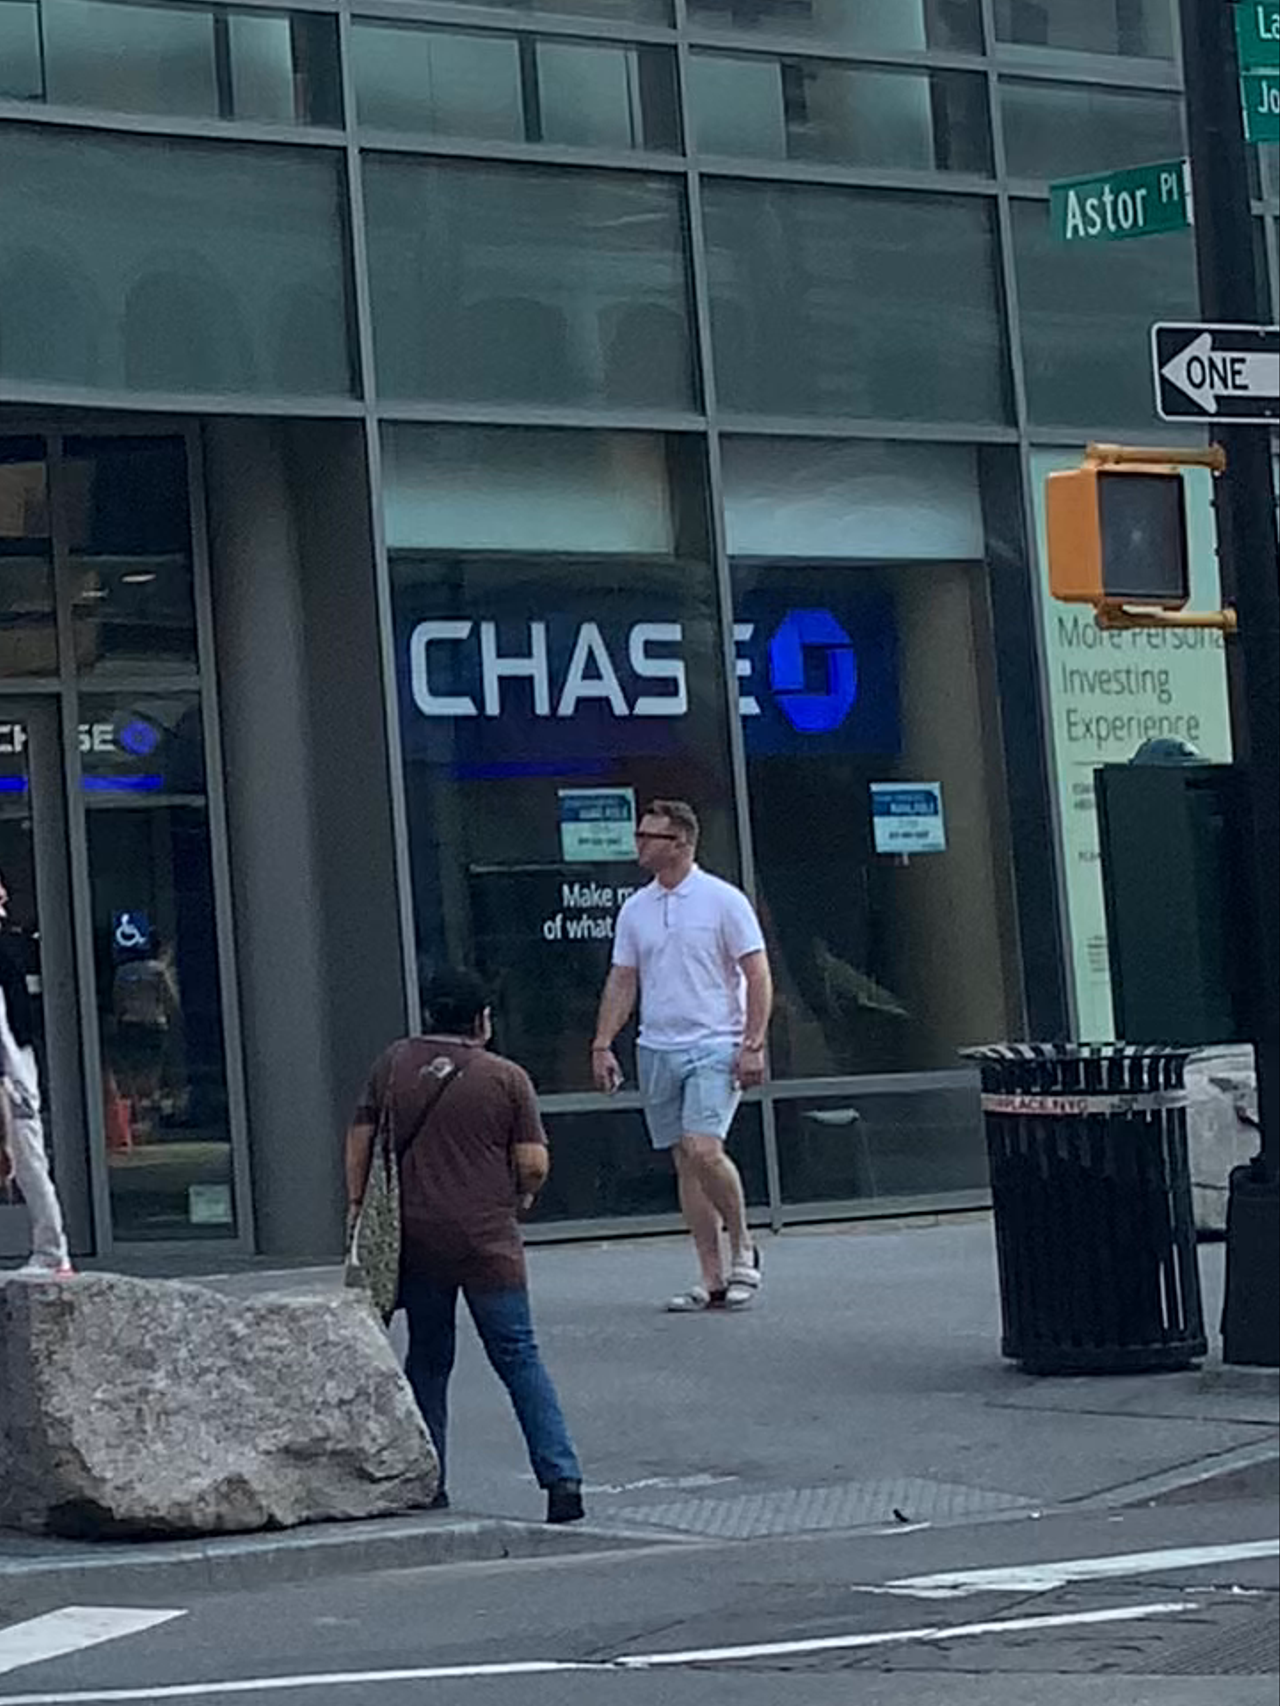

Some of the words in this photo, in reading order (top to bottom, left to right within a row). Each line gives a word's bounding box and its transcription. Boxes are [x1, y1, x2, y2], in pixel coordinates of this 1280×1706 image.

[1065, 184, 1148, 240] Astor
[1160, 172, 1178, 203] Pl
[1186, 355, 1250, 391] ONE
[1061, 661, 1174, 705] Investing
[1066, 707, 1201, 751] Experience
[562, 881, 614, 908] Make
[543, 913, 564, 941] of
[565, 913, 614, 940] what
